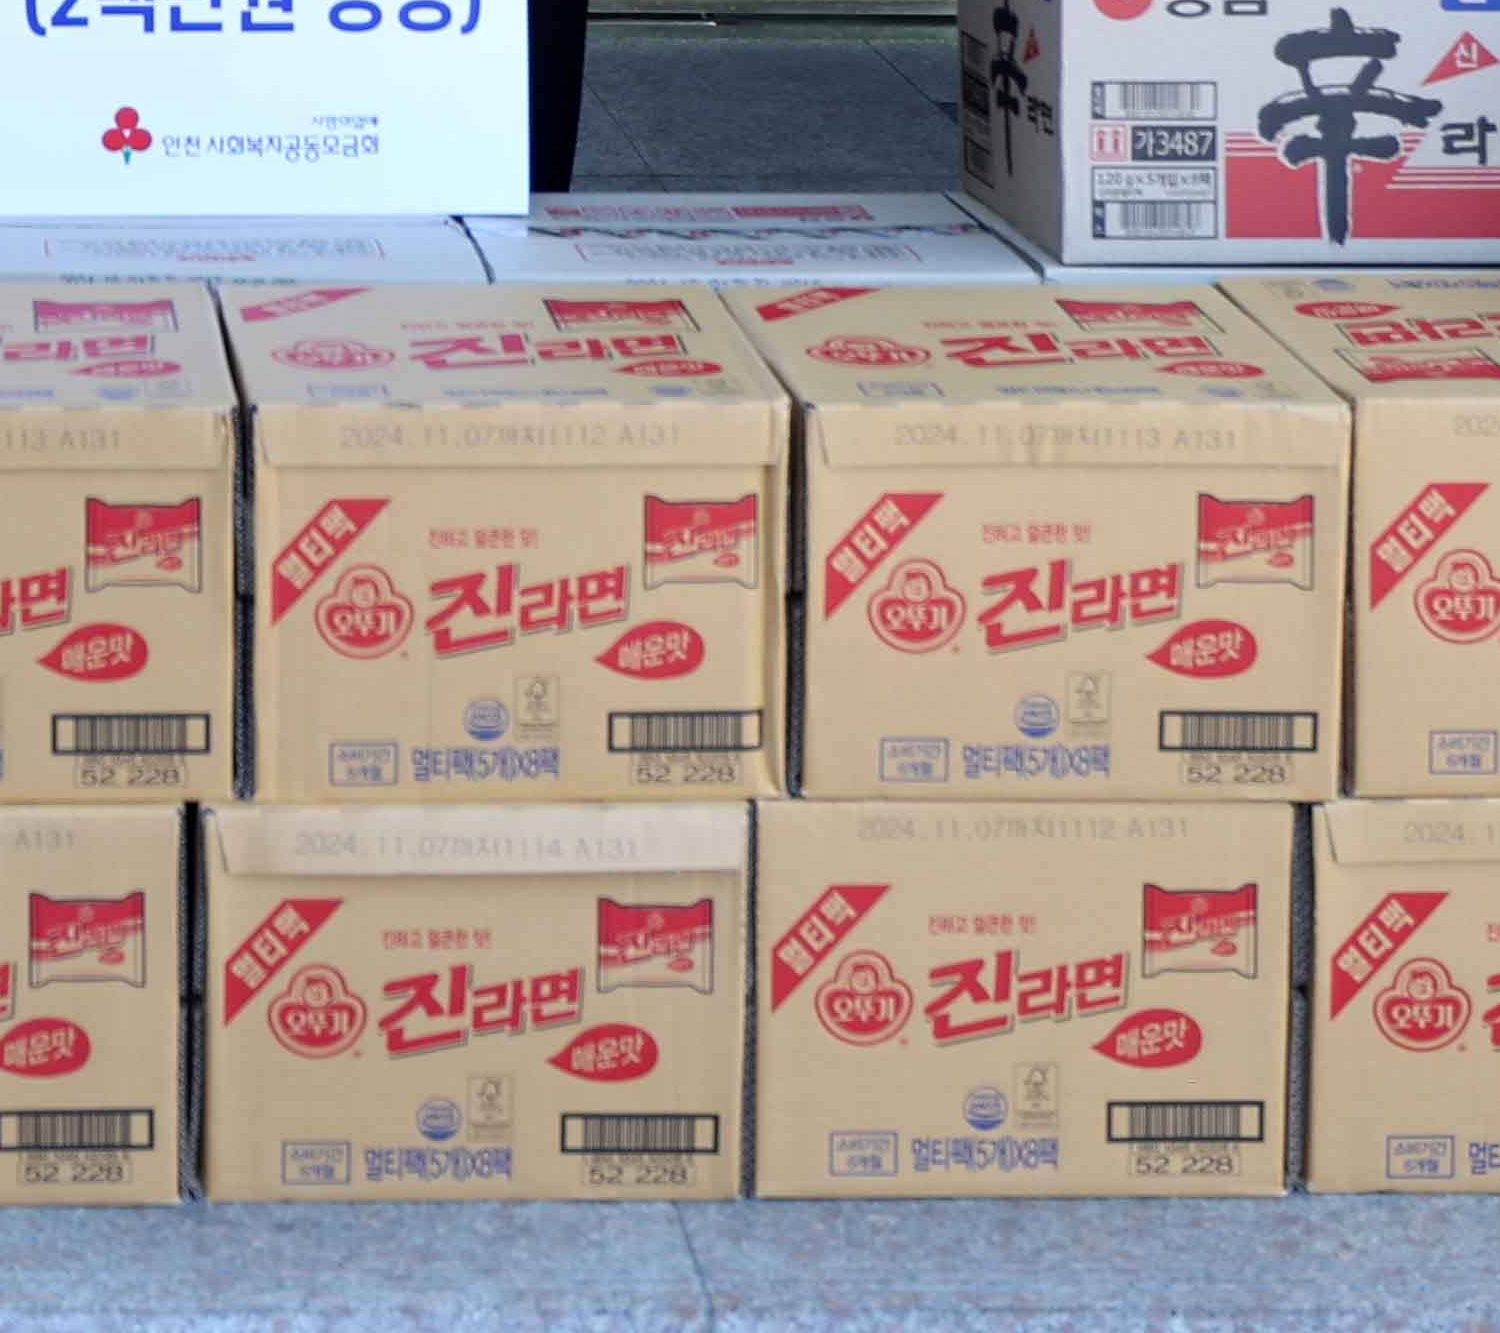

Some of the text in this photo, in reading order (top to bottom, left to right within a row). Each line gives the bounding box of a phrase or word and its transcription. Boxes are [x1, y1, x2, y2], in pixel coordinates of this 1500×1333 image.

[162, 135, 379, 162] 인천 사회복지공동모금회
[378, 962, 585, 1060] 진라면
[571, 1035, 645, 1074] 매운맛
